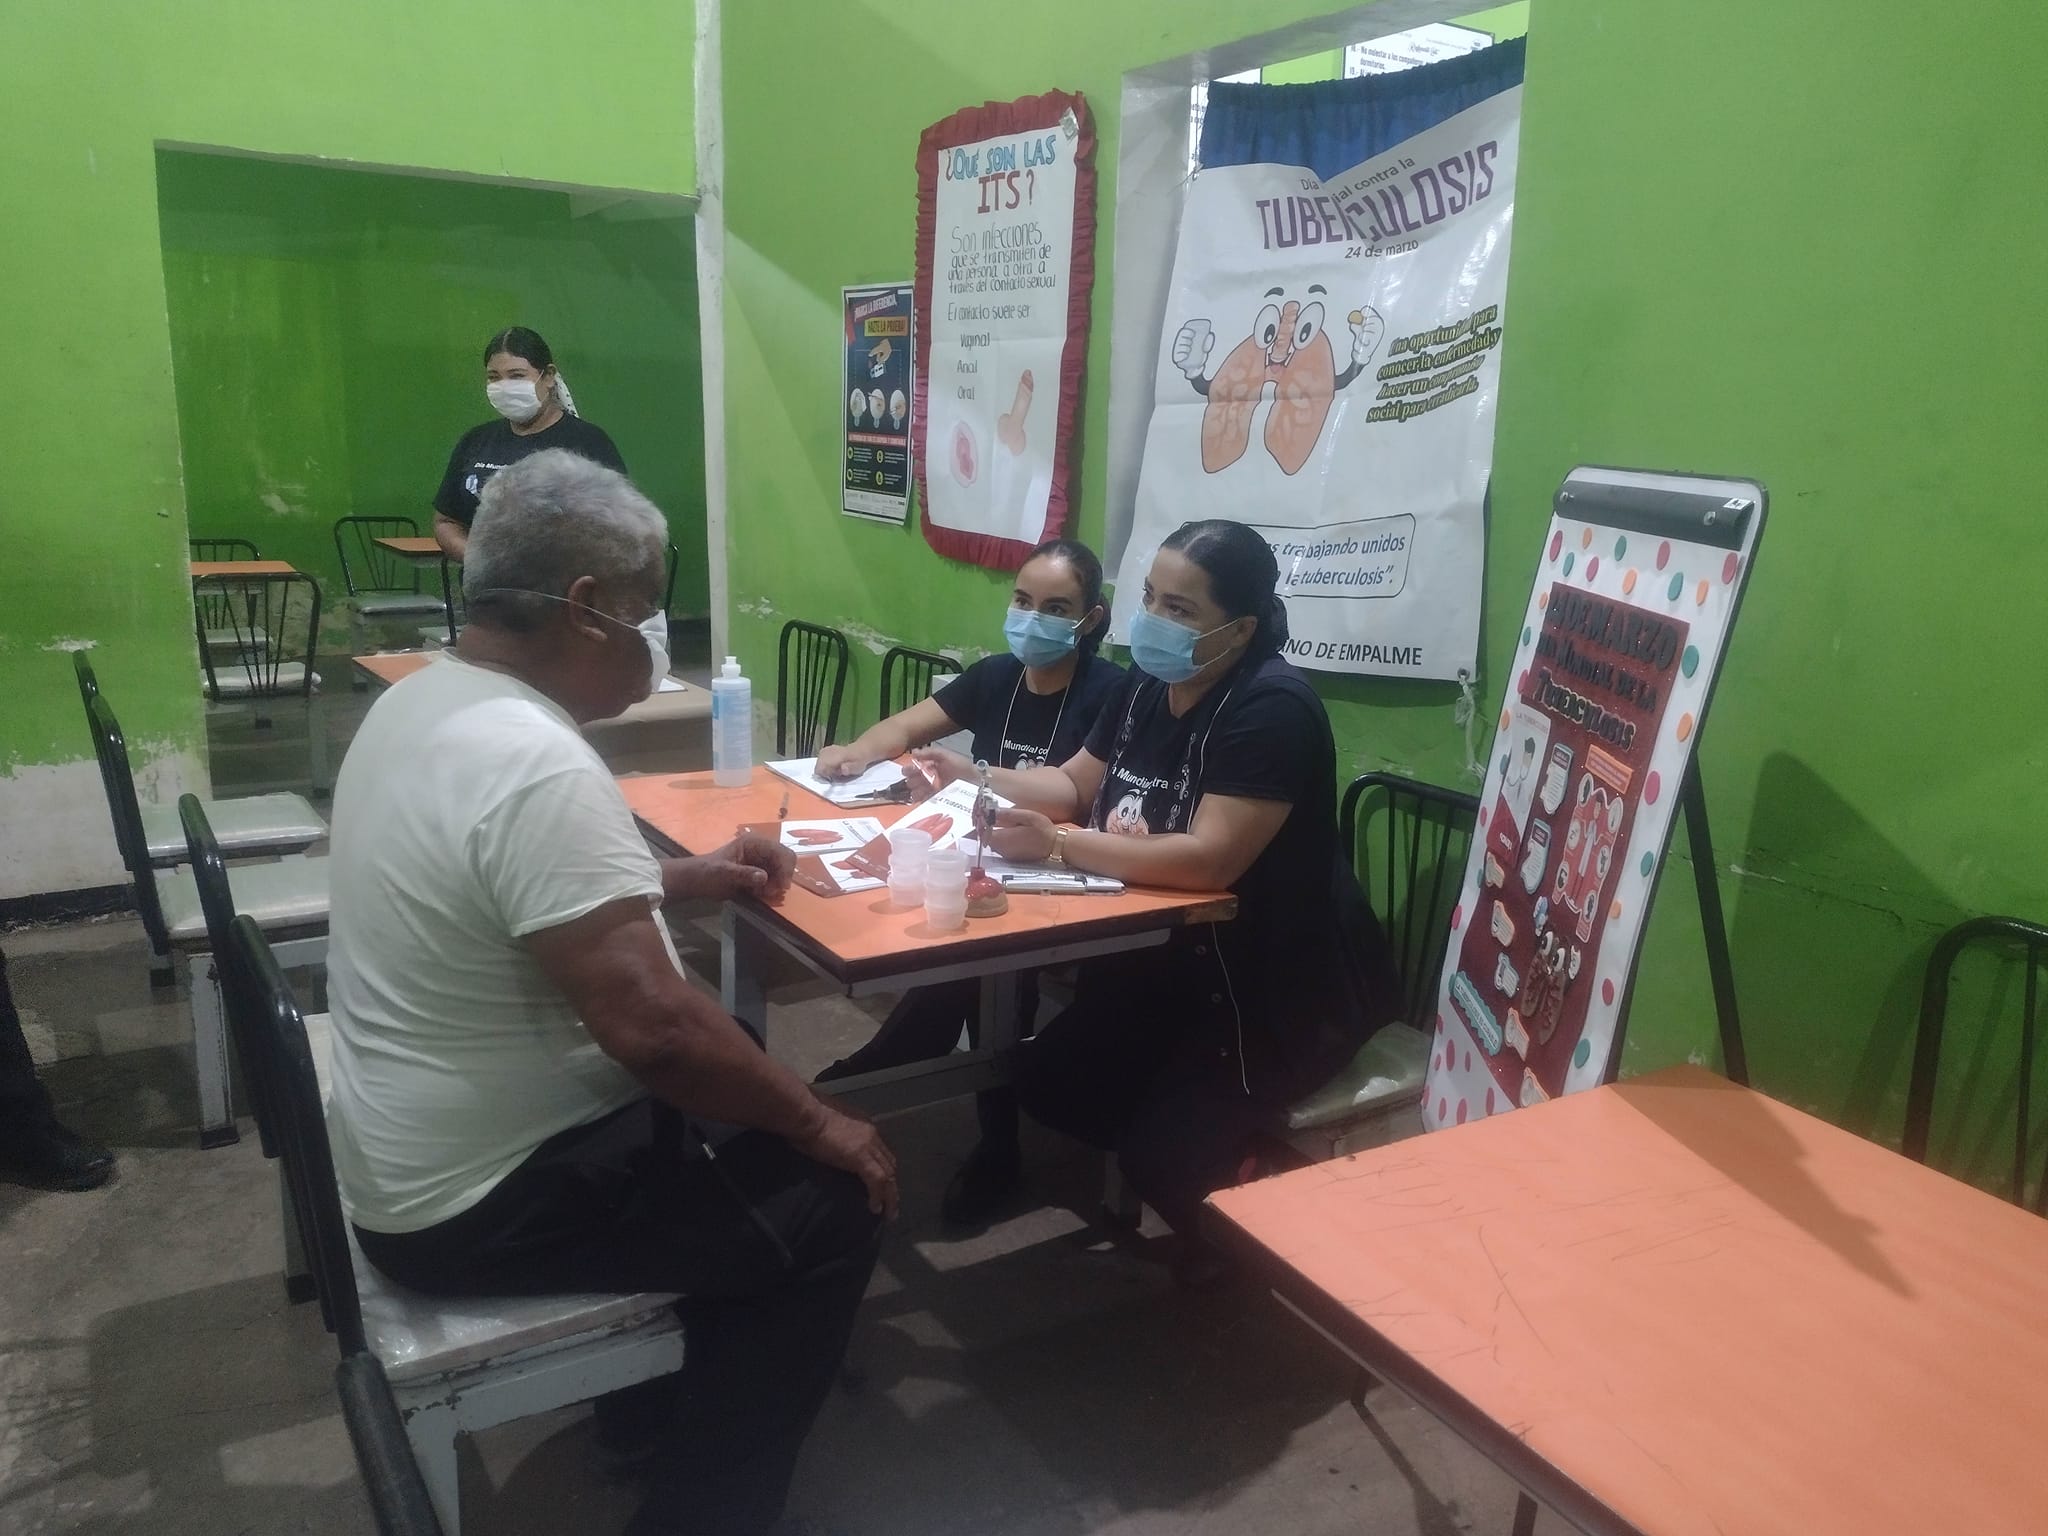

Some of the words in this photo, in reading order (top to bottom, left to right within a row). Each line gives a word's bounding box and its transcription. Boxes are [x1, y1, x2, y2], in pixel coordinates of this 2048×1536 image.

[985, 144, 1016, 174] SON
[1024, 135, 1056, 167] LAS
[1301, 178, 1320, 191] Día
[1354, 166, 1399, 191] contra
[1399, 157, 1415, 169] la
[1256, 140, 1497, 249] TUBERCULOSIS
[951, 226, 976, 254] Son
[982, 222, 1043, 251] infecciones
[1344, 246, 1361, 259] 24
[1365, 245, 1382, 257] de
[1385, 240, 1419, 256] marzo
[1039, 243, 1051, 259] de
[966, 265, 998, 283] persona
[1003, 265, 1010, 277] a
[1038, 260, 1046, 273] a
[990, 276, 1026, 292] contacto
[1027, 274, 1056, 289] sexual
[948, 302, 958, 321] El
[992, 304, 1015, 320] suele
[1017, 304, 1031, 319] ser
[1470, 304, 1498, 334] para
[1377, 357, 1420, 382] conocer
[1419, 351, 1433, 373] la
[1433, 327, 1490, 368] enfermedad
[957, 359, 978, 374] Anal
[957, 385, 975, 401] Oral
[1376, 383, 1411, 400] hacer
[1410, 378, 1430, 395] un
[1366, 400, 1401, 423] social
[1398, 398, 1429, 423] para
[1282, 537, 1358, 560] trabajando
[1361, 532, 1406, 555] unidos
[1315, 642, 1337, 660] DE
[1338, 643, 1423, 665] EMPALME
[1004, 739, 1038, 754] Mundial
